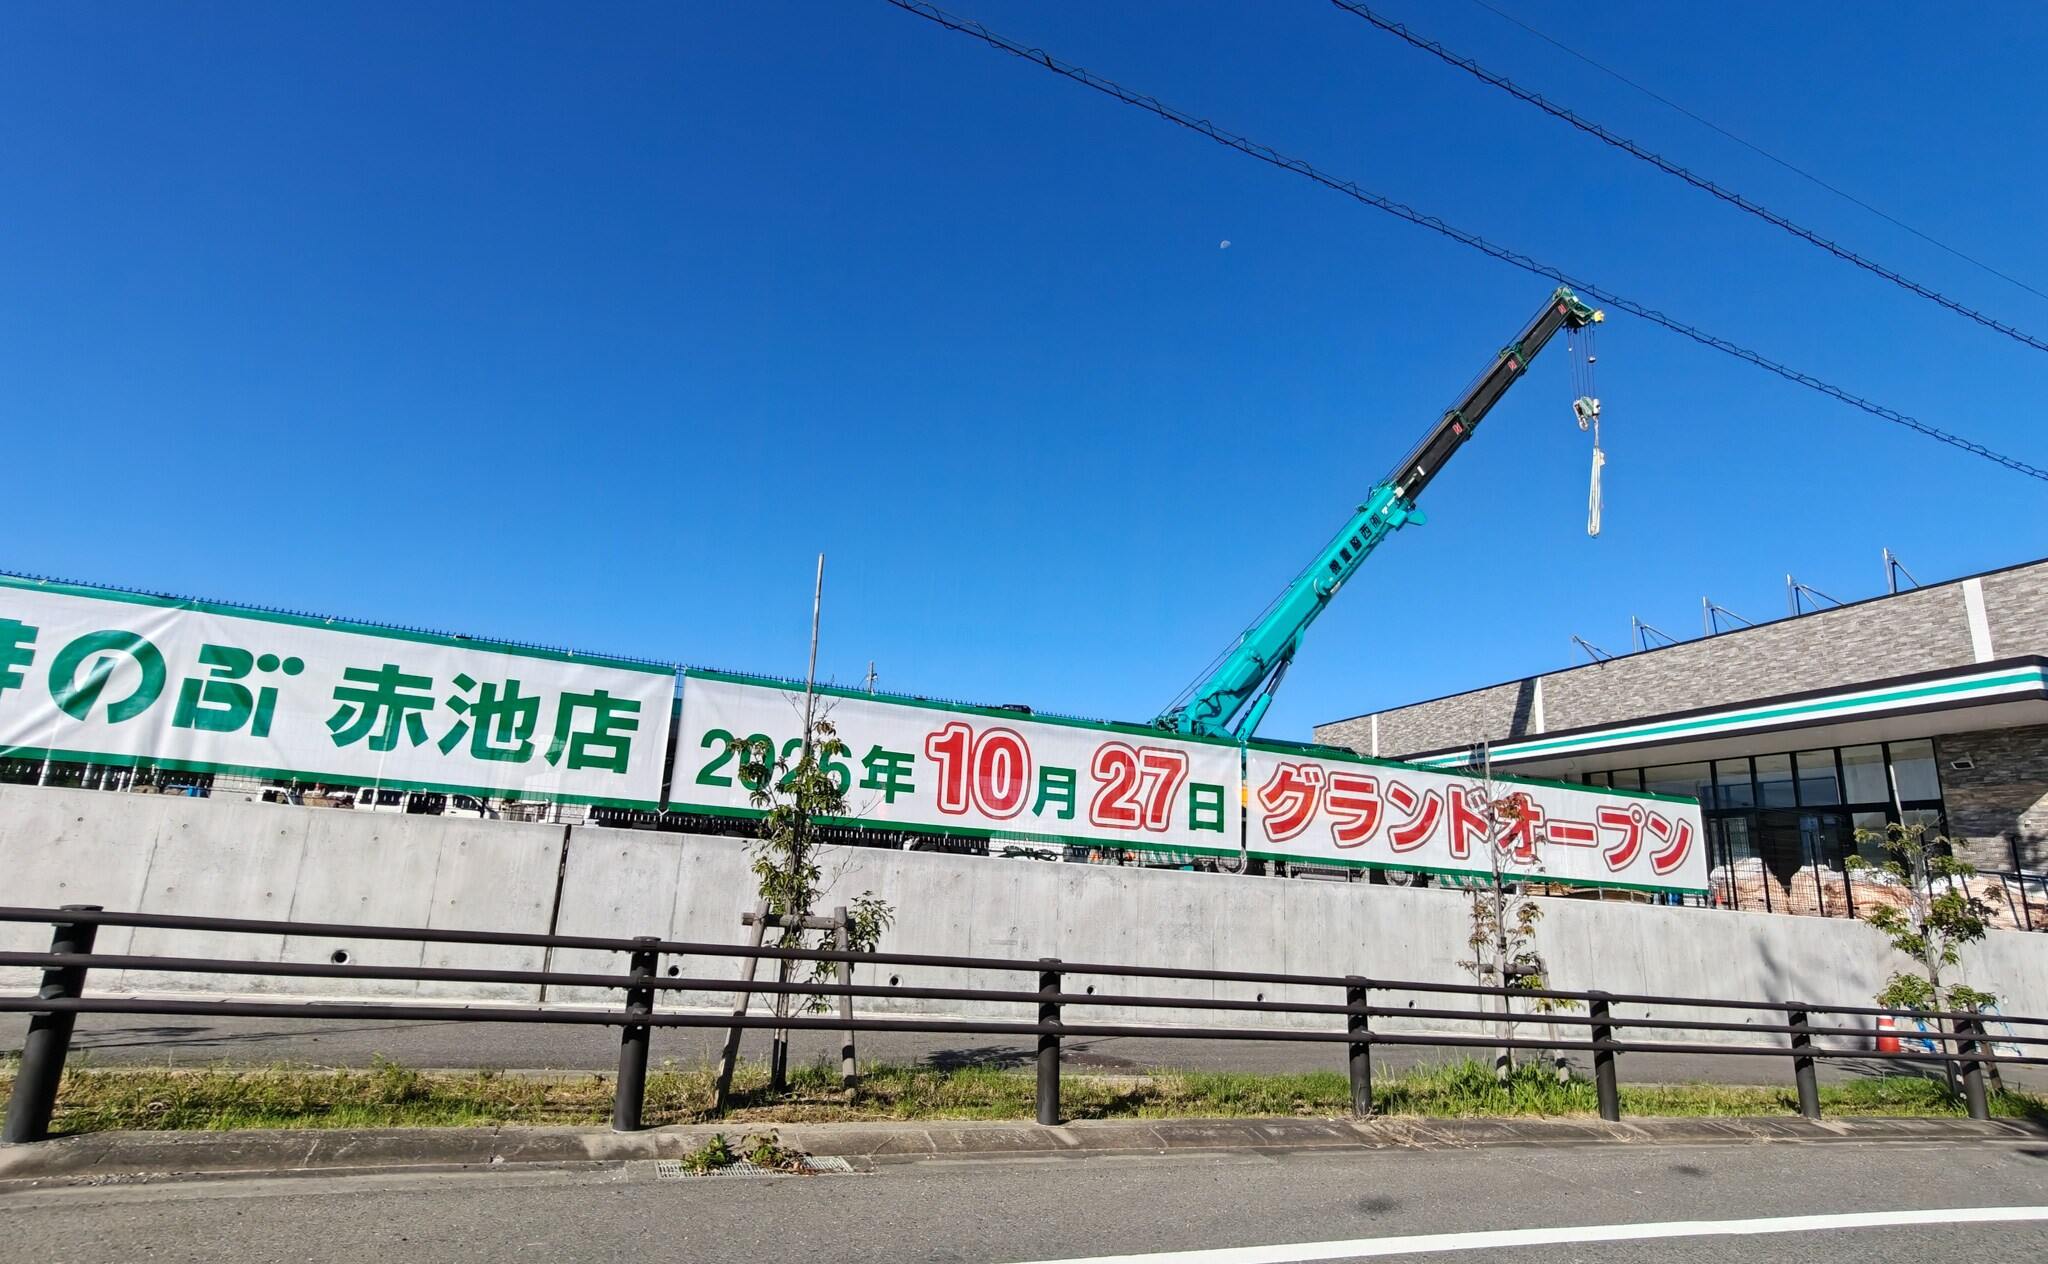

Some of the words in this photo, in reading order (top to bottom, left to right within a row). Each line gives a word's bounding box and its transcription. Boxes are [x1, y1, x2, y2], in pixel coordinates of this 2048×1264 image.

[325, 664, 641, 774] 赤池店
[1257, 761, 1693, 876] グランドオープン
